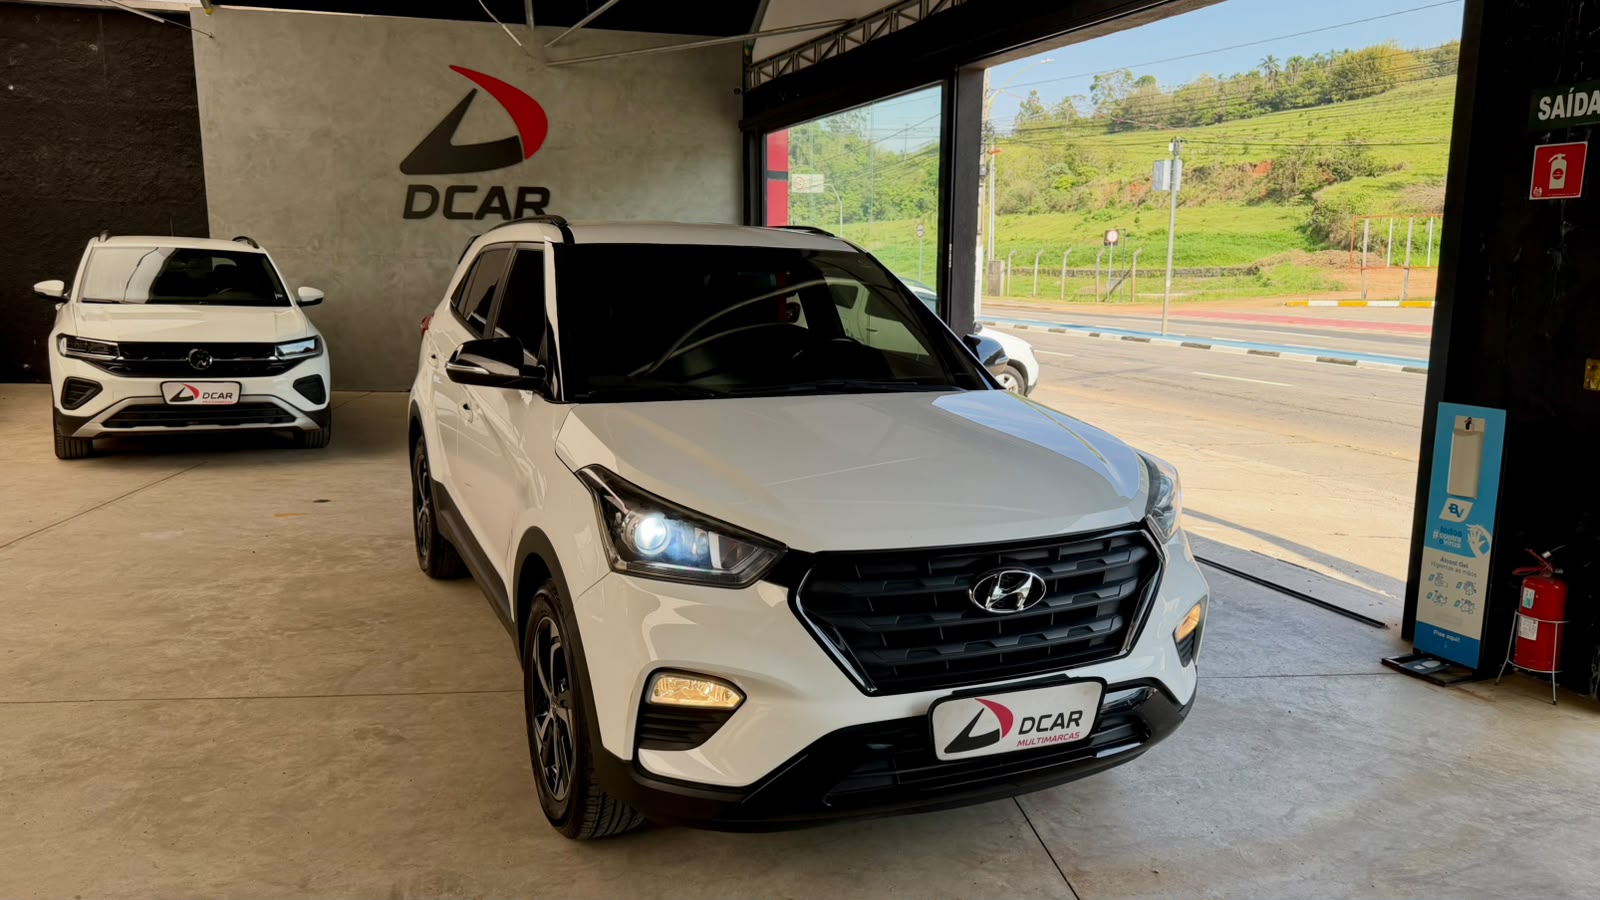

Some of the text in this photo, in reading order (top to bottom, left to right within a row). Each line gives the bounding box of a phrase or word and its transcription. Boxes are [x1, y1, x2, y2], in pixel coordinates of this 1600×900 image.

[1538, 87, 1600, 121] SAÍDA
[403, 184, 550, 220] DCAR
[1018, 710, 1083, 735] DCAR
[1016, 732, 1081, 747] MULTIMARCAS
